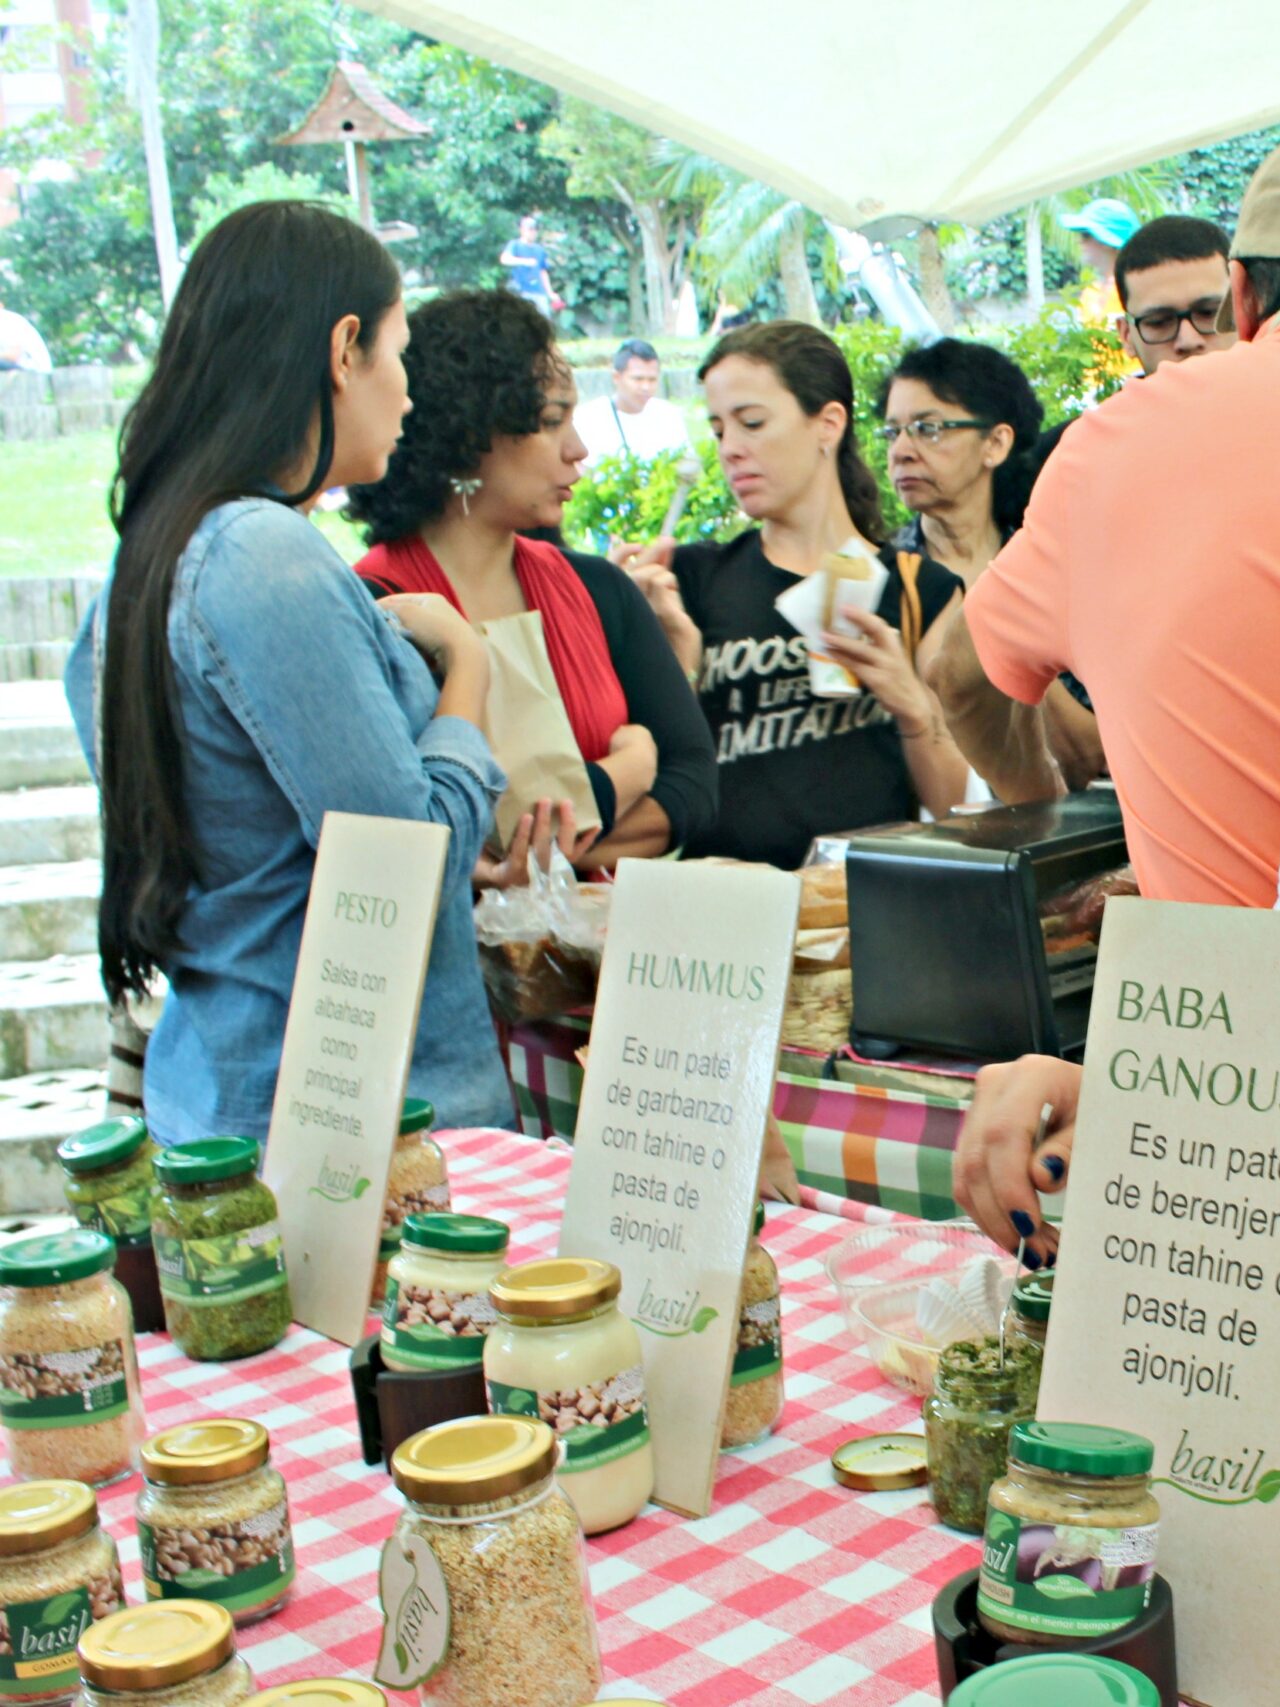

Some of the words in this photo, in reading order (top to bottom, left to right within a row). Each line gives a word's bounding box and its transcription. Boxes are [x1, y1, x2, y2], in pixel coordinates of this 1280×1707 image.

[702, 635, 809, 692] HOOS
[716, 695, 892, 764] IMITATIO
[334, 891, 398, 929] PESTO
[320, 958, 358, 988] Salsa
[360, 972, 387, 994] con
[627, 952, 766, 1002] HUMMUS
[314, 995, 376, 1029] albahaca
[1117, 979, 1233, 1035] BABA
[320, 1035, 358, 1061] como
[622, 1036, 648, 1066] Es
[654, 1047, 679, 1071] un
[304, 1066, 363, 1101] principal
[607, 1077, 632, 1107] de
[636, 1087, 734, 1126] garbanzo
[601, 1125, 637, 1151] con
[644, 1128, 706, 1166] tahine
[712, 1148, 726, 1170] o
[1129, 1122, 1167, 1160] Es
[1179, 1138, 1216, 1169] un
[318, 1153, 361, 1194] basil
[611, 1170, 667, 1203] pasta
[673, 1180, 700, 1210] de
[1104, 1173, 1140, 1209] de
[1104, 1234, 1156, 1268] con
[1168, 1240, 1263, 1290] tahine
[637, 1278, 700, 1327] basil
[1122, 1292, 1206, 1335] pasta
[1218, 1308, 1257, 1346] de
[1122, 1343, 1239, 1400] ajonjolí.
[1170, 1429, 1265, 1494] basil
[21, 1608, 88, 1655] basil
[401, 1586, 438, 1664] basil
